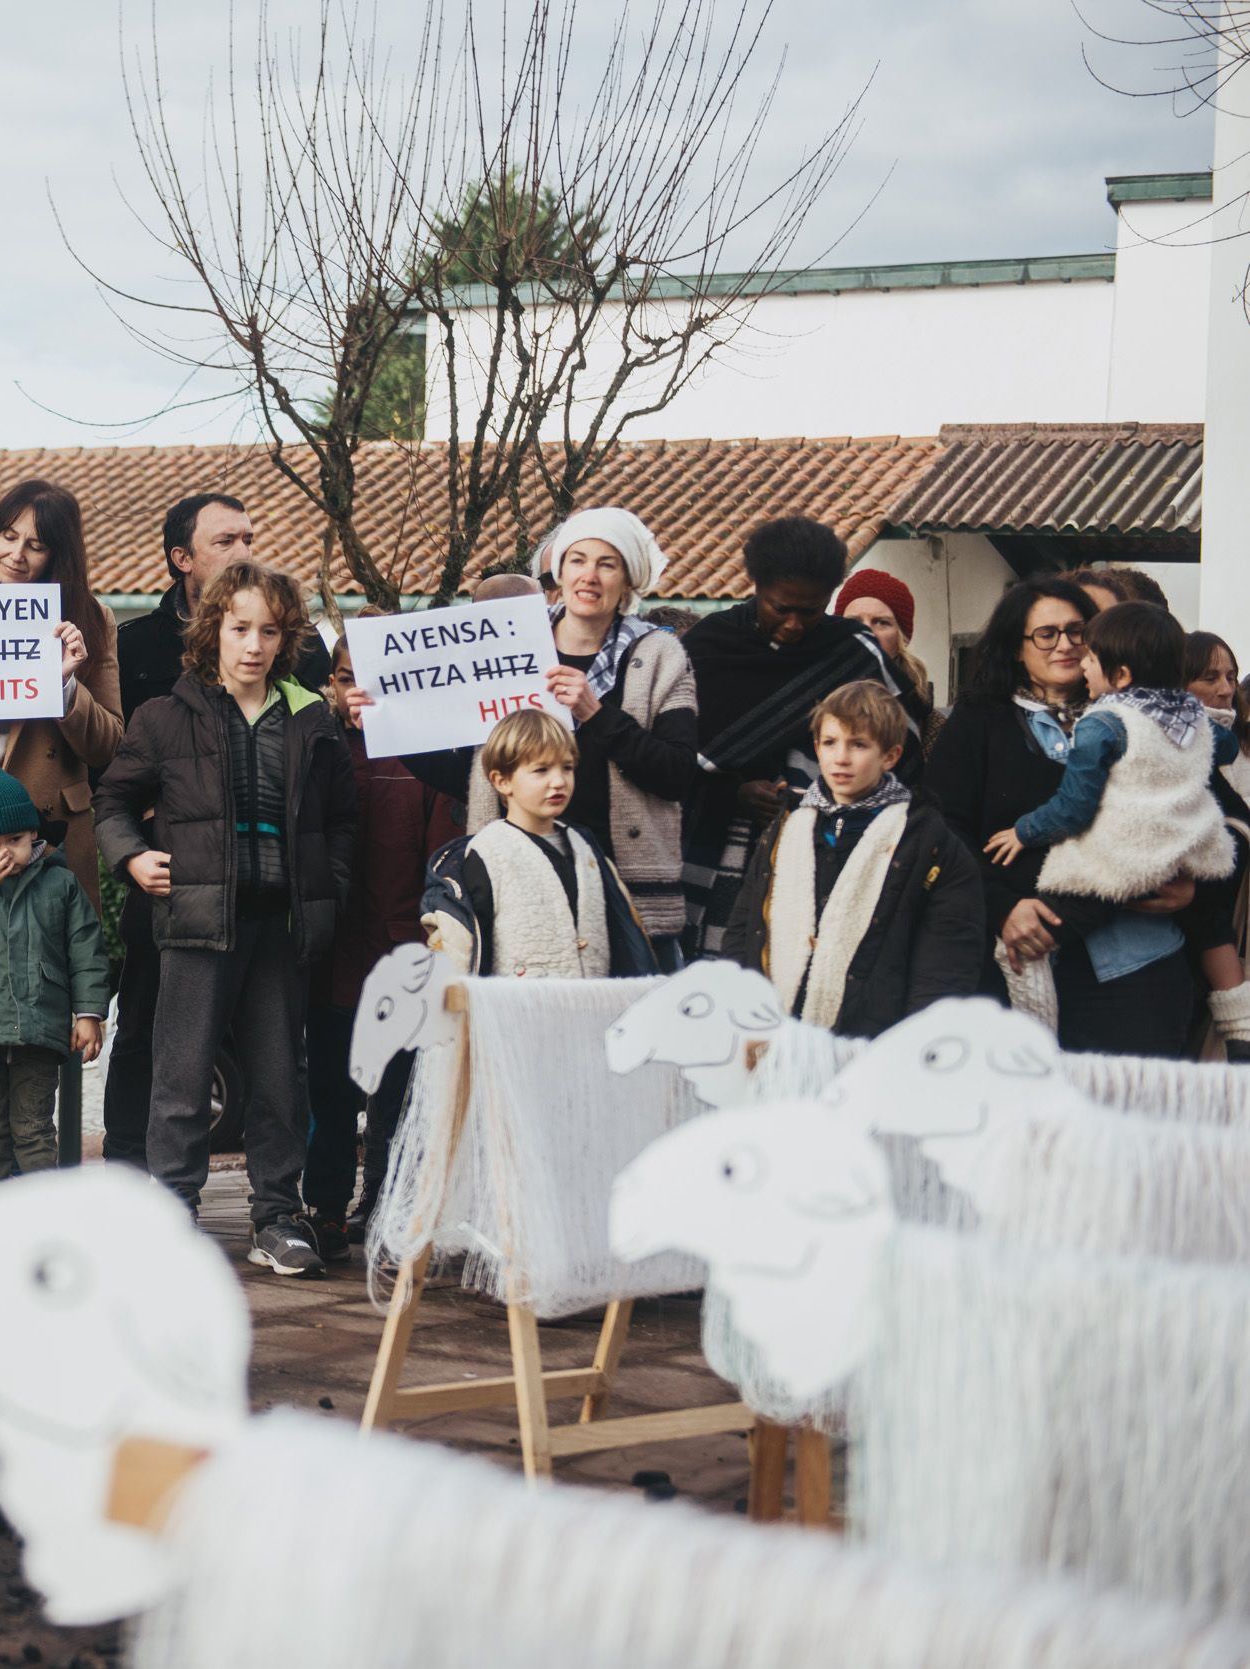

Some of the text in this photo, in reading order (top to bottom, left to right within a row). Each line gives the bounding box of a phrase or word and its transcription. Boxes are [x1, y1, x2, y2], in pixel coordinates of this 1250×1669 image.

[384, 619, 498, 655] AYENSA
[379, 653, 538, 694] HITZA HITZ
[479, 694, 543, 722] HITS
